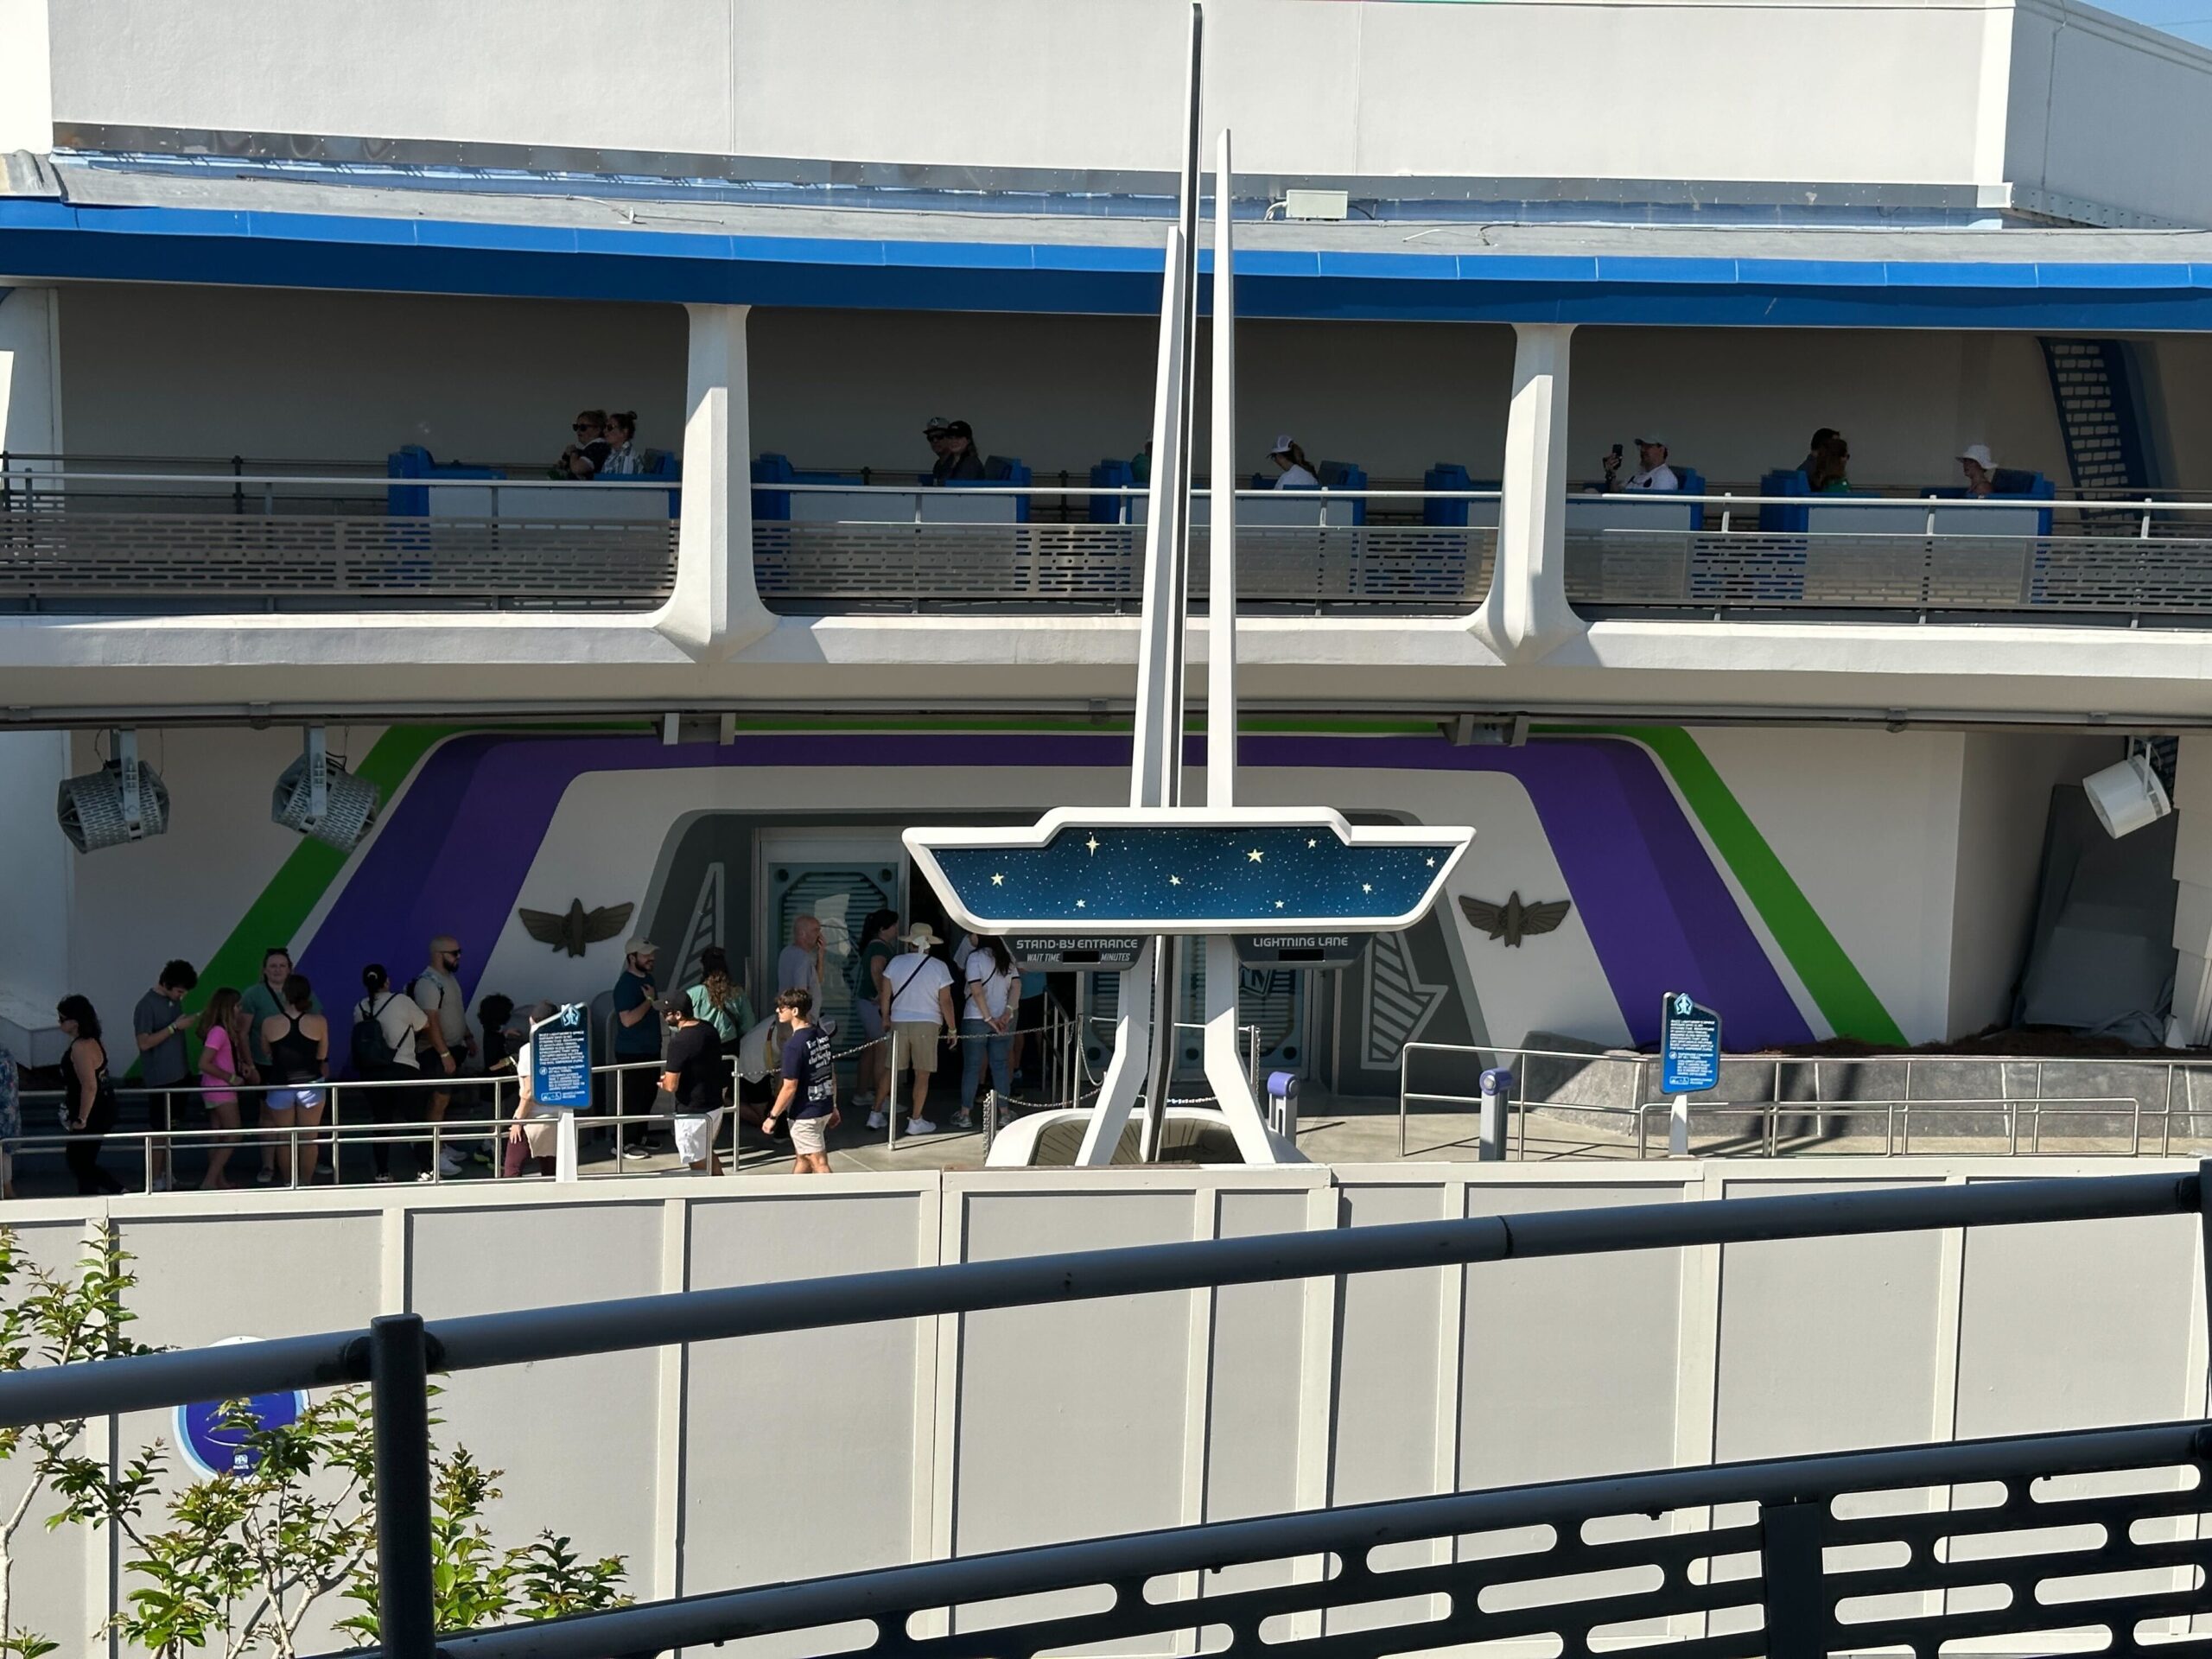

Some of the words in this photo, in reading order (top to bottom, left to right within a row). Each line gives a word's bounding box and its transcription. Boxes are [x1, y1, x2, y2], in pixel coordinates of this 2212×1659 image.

[1016, 939, 1075, 949] STAND-BY
[1077, 939, 1138, 949] ENTRANCE
[1253, 937, 1315, 947] LIGHTNING
[1318, 937, 1349, 946] LANE
[1027, 953, 1044, 962] WAIT
[1045, 953, 1060, 962] TIME
[1101, 953, 1130, 962] MINUTES
